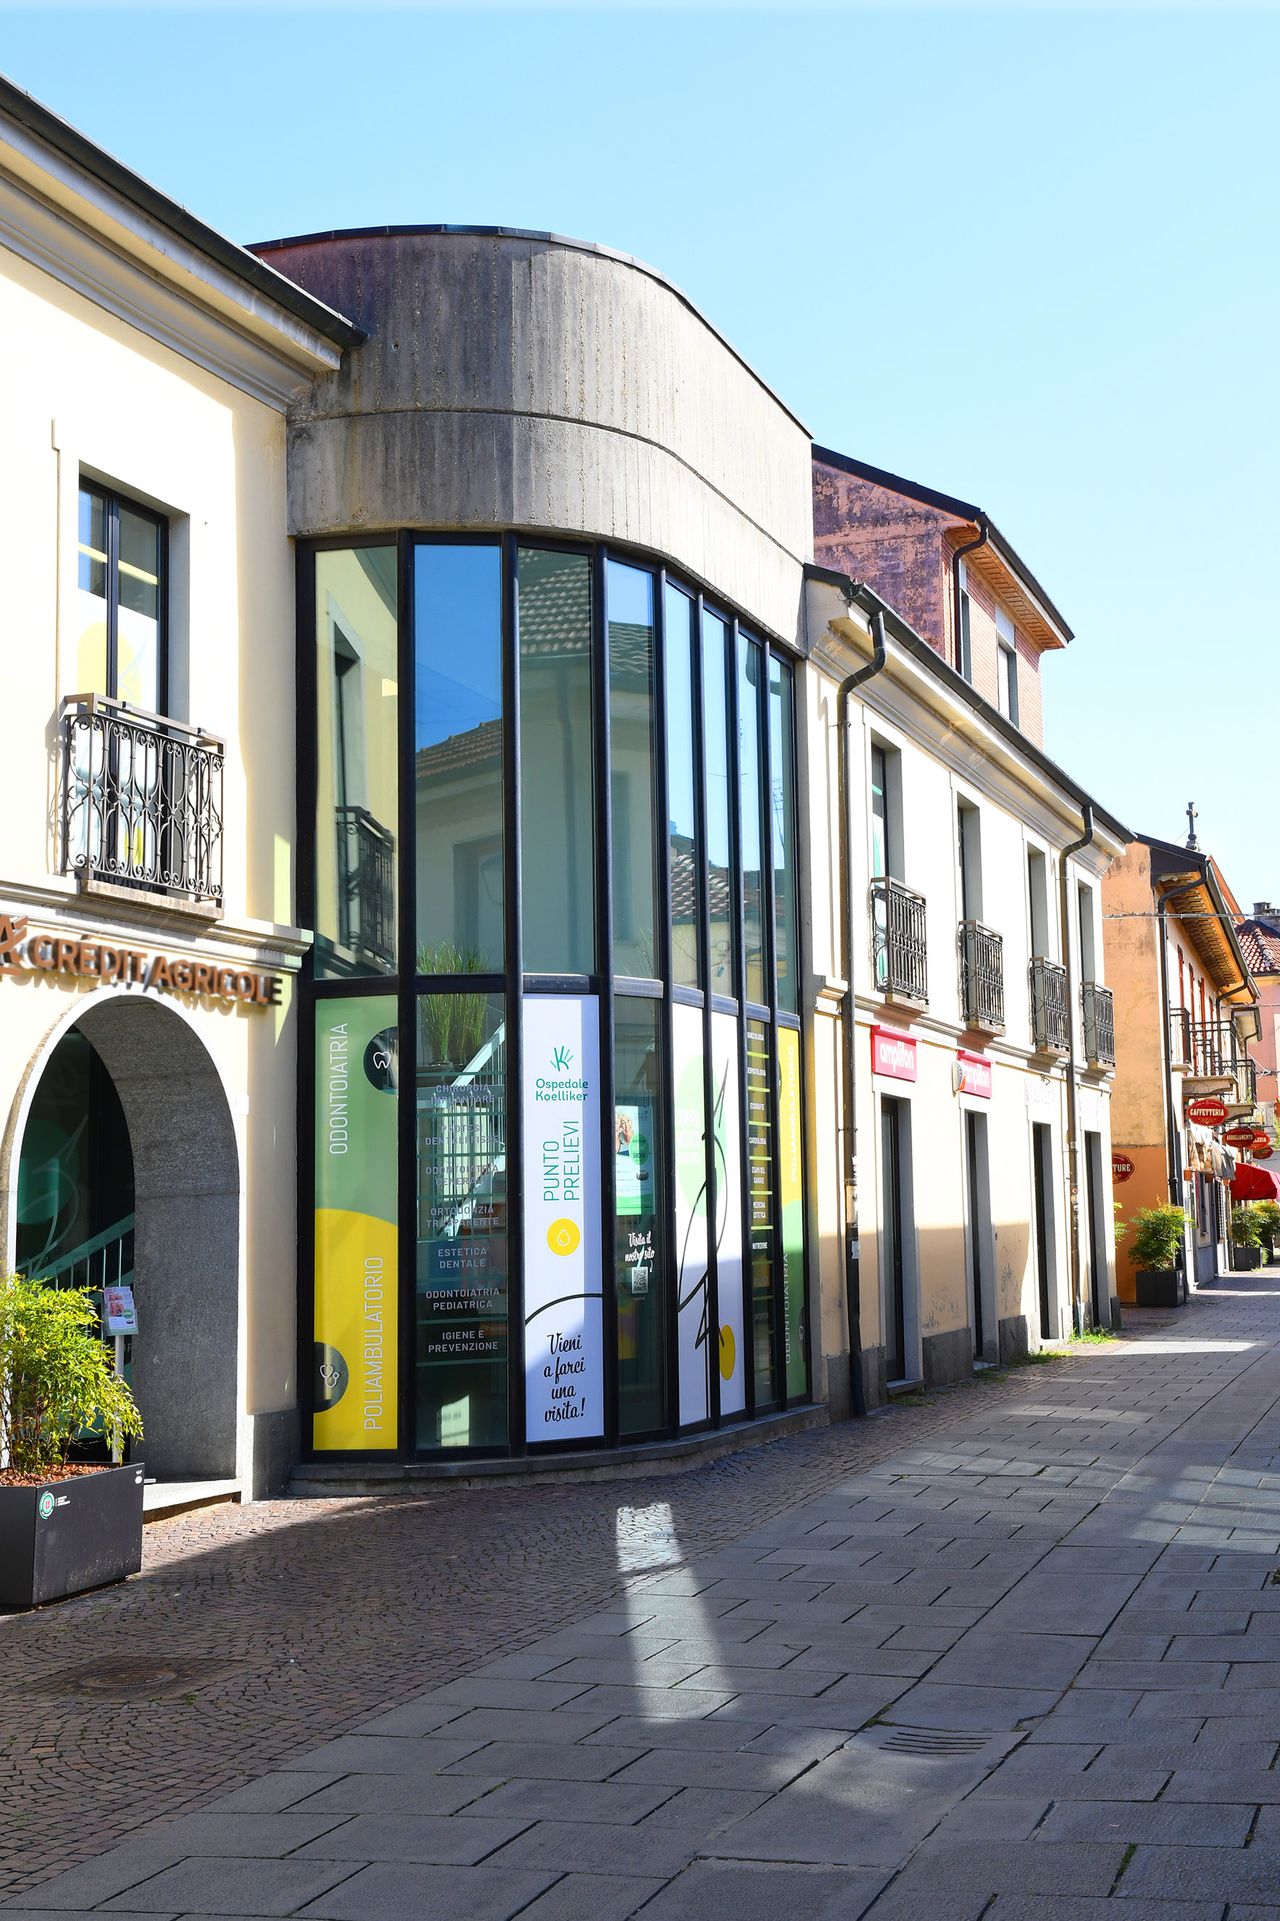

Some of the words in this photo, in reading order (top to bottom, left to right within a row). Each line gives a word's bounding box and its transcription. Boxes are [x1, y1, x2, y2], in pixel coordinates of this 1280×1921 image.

[28, 934, 147, 983] CRÉDIT
[151, 955, 283, 1005] AGRICOLE
[879, 1039, 914, 1072] amplifon
[329, 1023, 348, 1155] ODONTOIATRIA
[435, 1084, 489, 1093] CHIRURGIA
[535, 1078, 589, 1090] Ospedale
[535, 1090, 589, 1102] Koelliker
[1189, 1108, 1224, 1117] CAFFETTERIA
[563, 1120, 580, 1201] PRELIEVI
[543, 1140, 560, 1201] PUNTO
[430, 1206, 495, 1216] ORTODONZIA
[426, 1217, 499, 1228] TRASPARENTE
[627, 1231, 646, 1247] Visita
[438, 1247, 487, 1257] ESTETICA
[439, 1258, 486, 1269] DENTALE
[425, 1288, 500, 1299] ODONTOIATRIA
[433, 1300, 493, 1311] PEDIATRICA
[442, 1331, 475, 1340] IGIENE
[478, 1330, 485, 1339] E
[363, 1256, 383, 1431] POLIAMBULATORIO
[428, 1341, 499, 1353] PREVENZIONE
[547, 1332, 582, 1355] Vieni
[543, 1366, 553, 1377] a
[553, 1356, 586, 1383] farci
[551, 1386, 576, 1400] una
[544, 1398, 586, 1423] visita!
